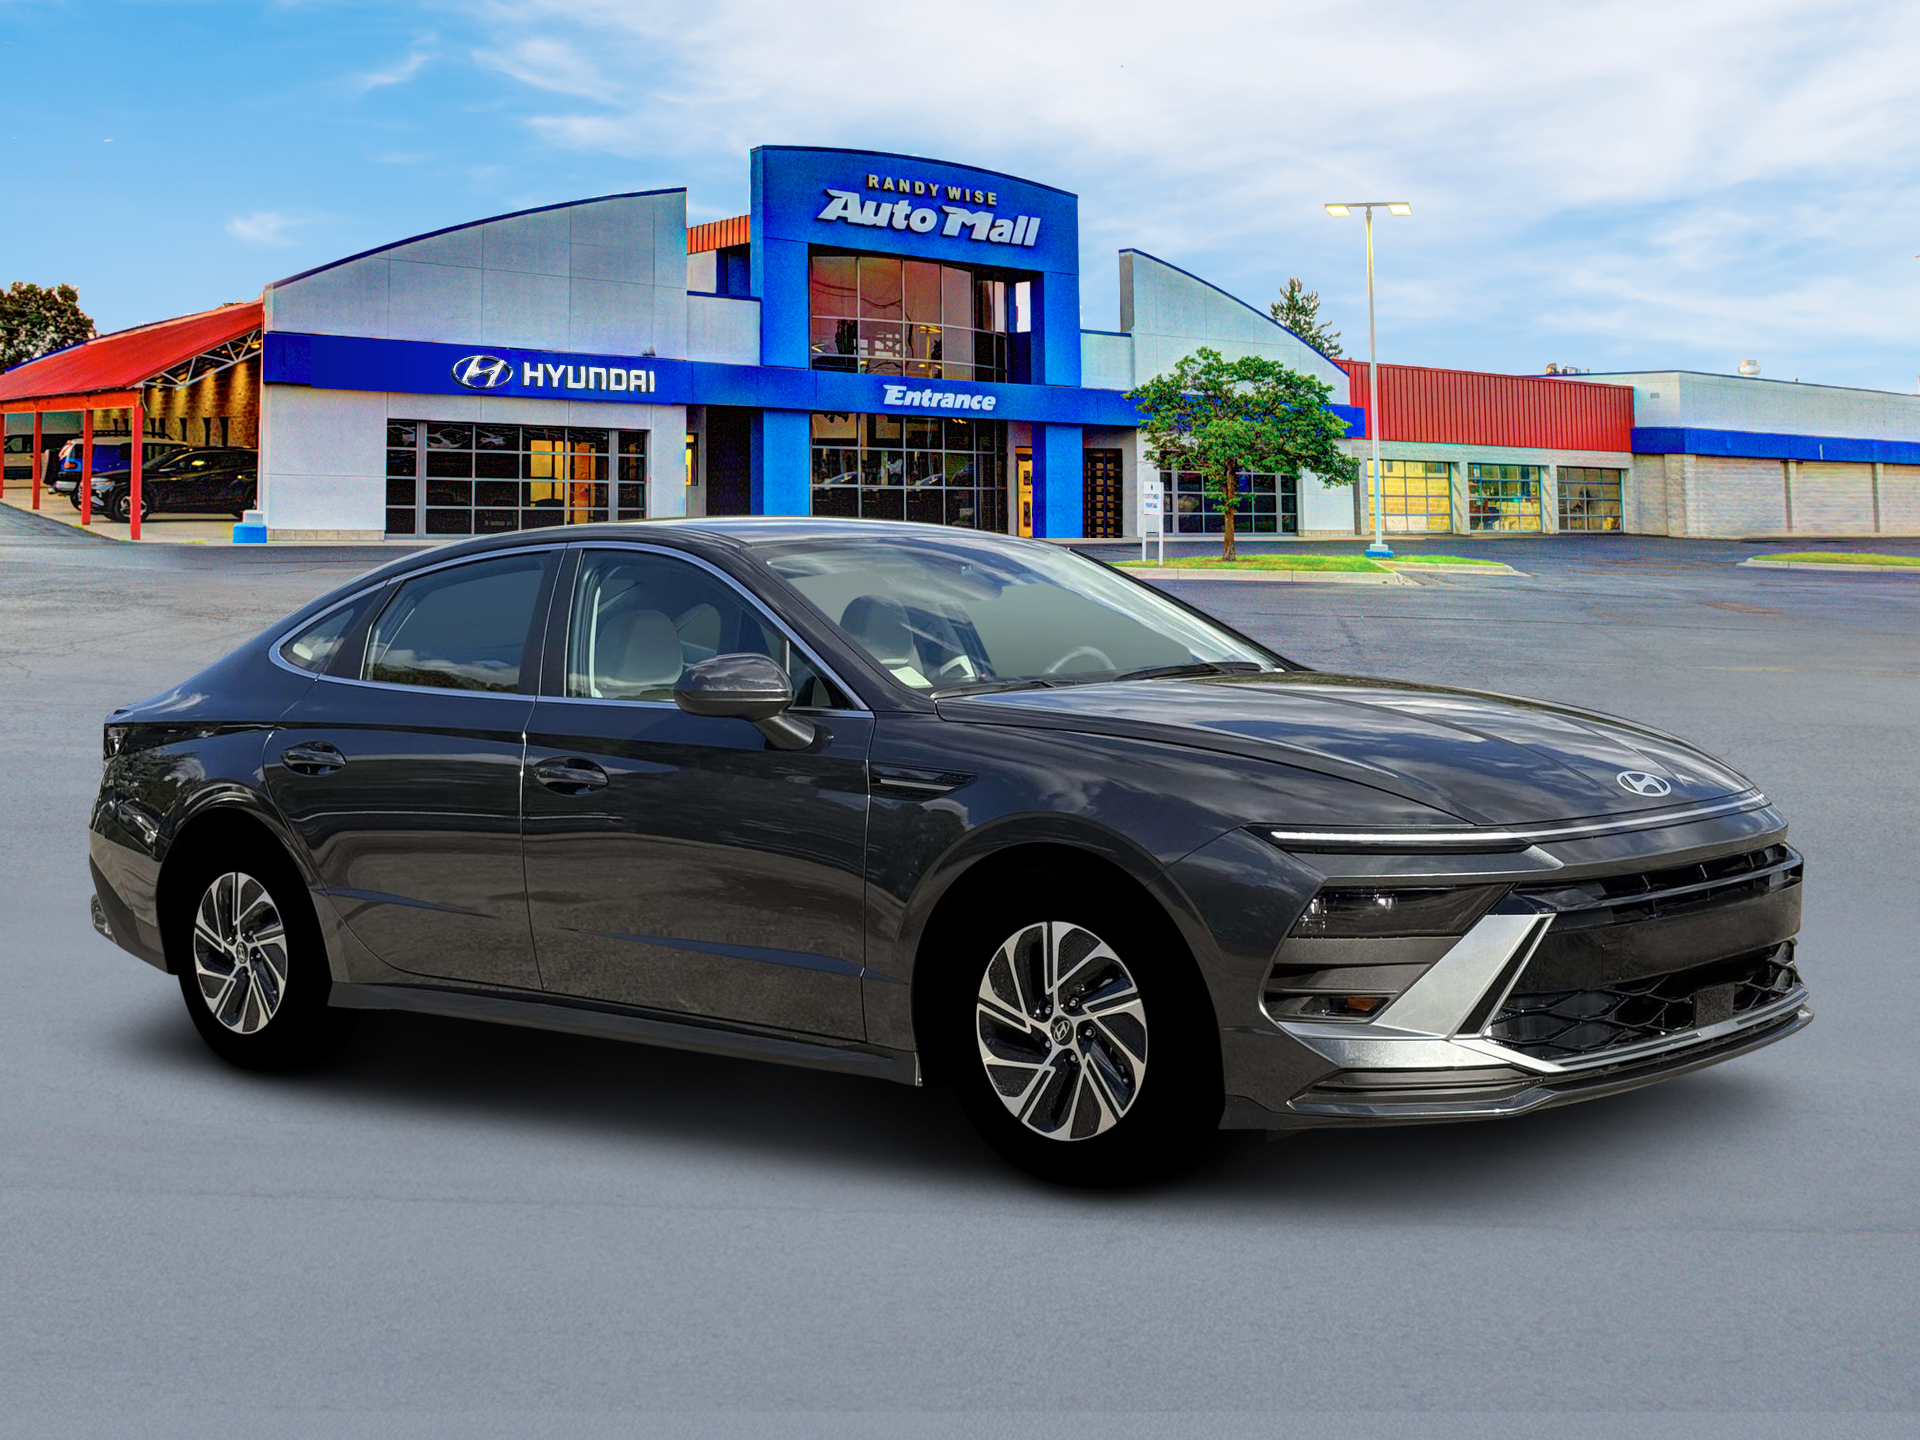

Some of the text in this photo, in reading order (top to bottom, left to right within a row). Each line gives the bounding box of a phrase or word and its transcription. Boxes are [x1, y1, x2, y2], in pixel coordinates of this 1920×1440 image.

[867, 174, 998, 206] RANDY WISE
[817, 188, 1041, 247] Auto Mall
[521, 362, 656, 393] HYUNDAI
[882, 384, 997, 412] Entrance
